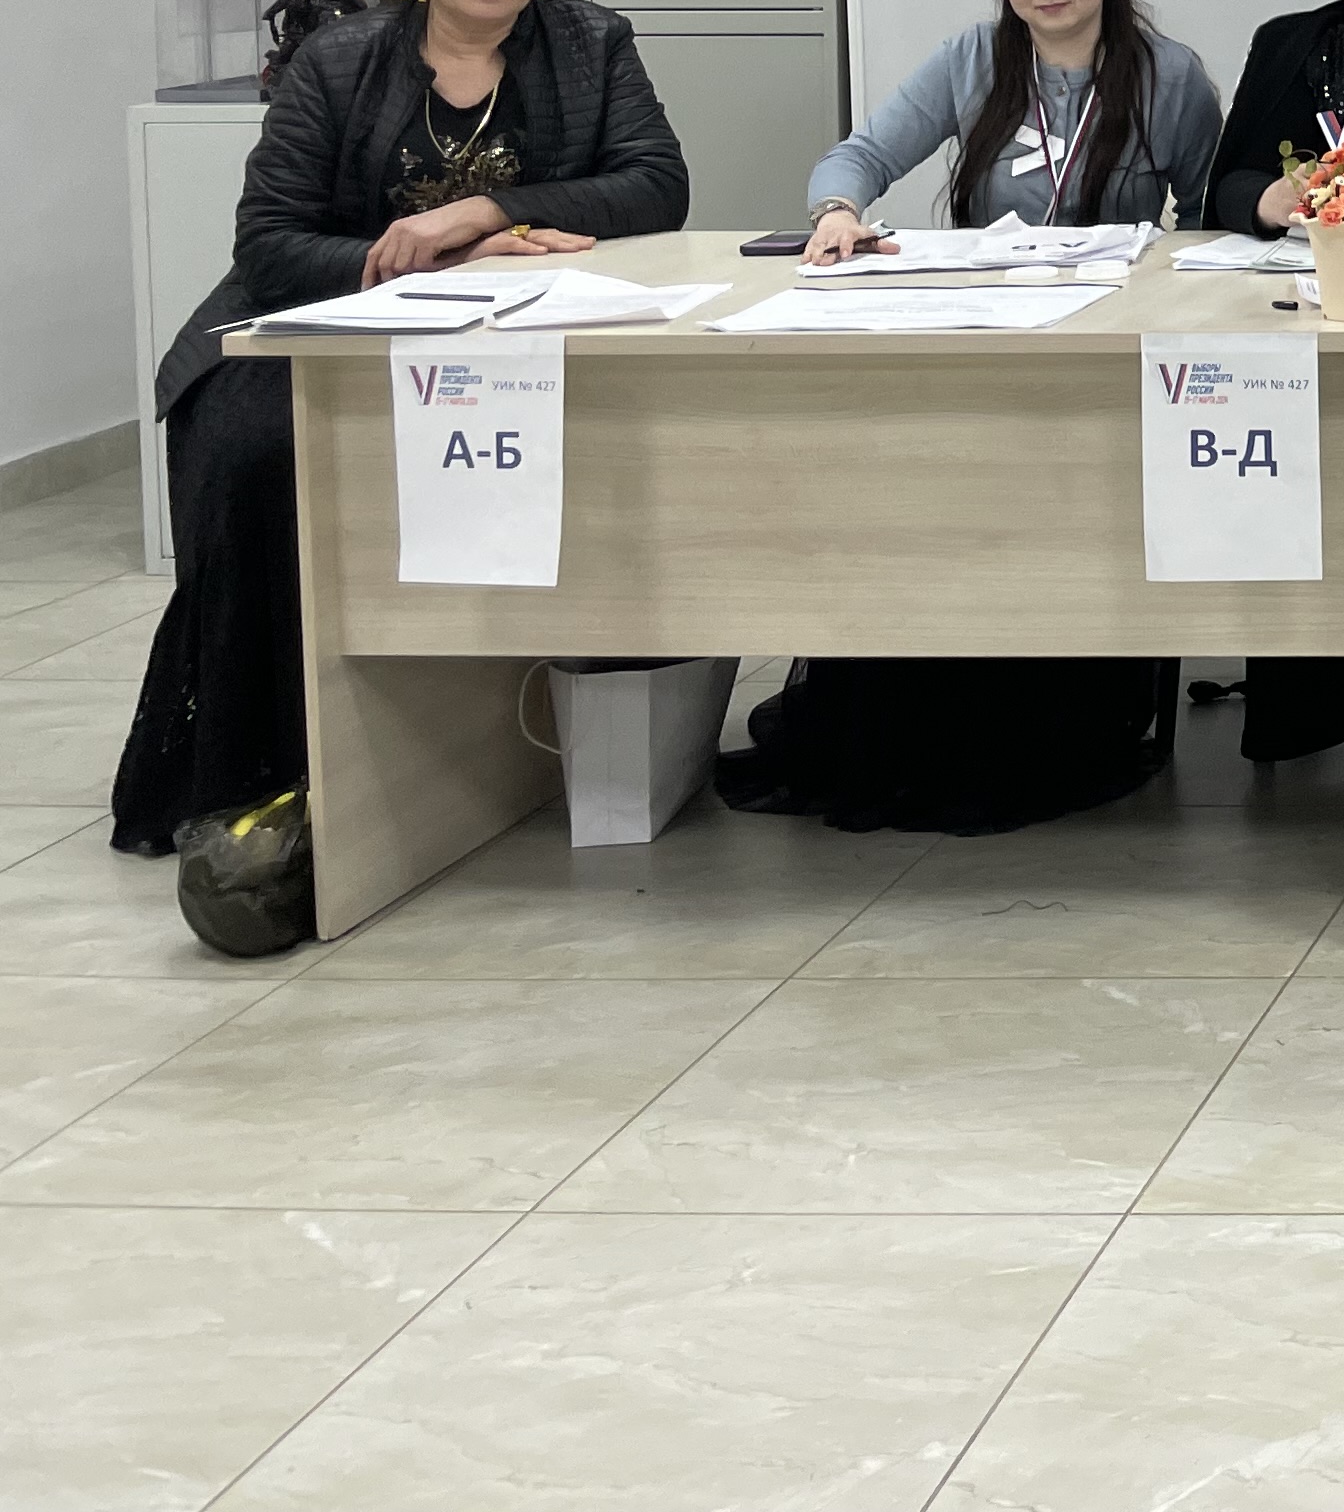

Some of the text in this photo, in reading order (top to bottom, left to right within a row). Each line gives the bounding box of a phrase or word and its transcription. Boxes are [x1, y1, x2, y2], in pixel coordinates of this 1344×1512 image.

[1192, 363, 1221, 372] ВЫБОРЫ
[1188, 374, 1234, 384] ПРЕЗИДЕНТА
[1243, 379, 1310, 390] УИК № 427
[492, 380, 556, 391] УИК № 427
[1186, 386, 1214, 394] РОССИИ
[442, 430, 522, 470] А-Б
[1190, 429, 1278, 477] В-Д
